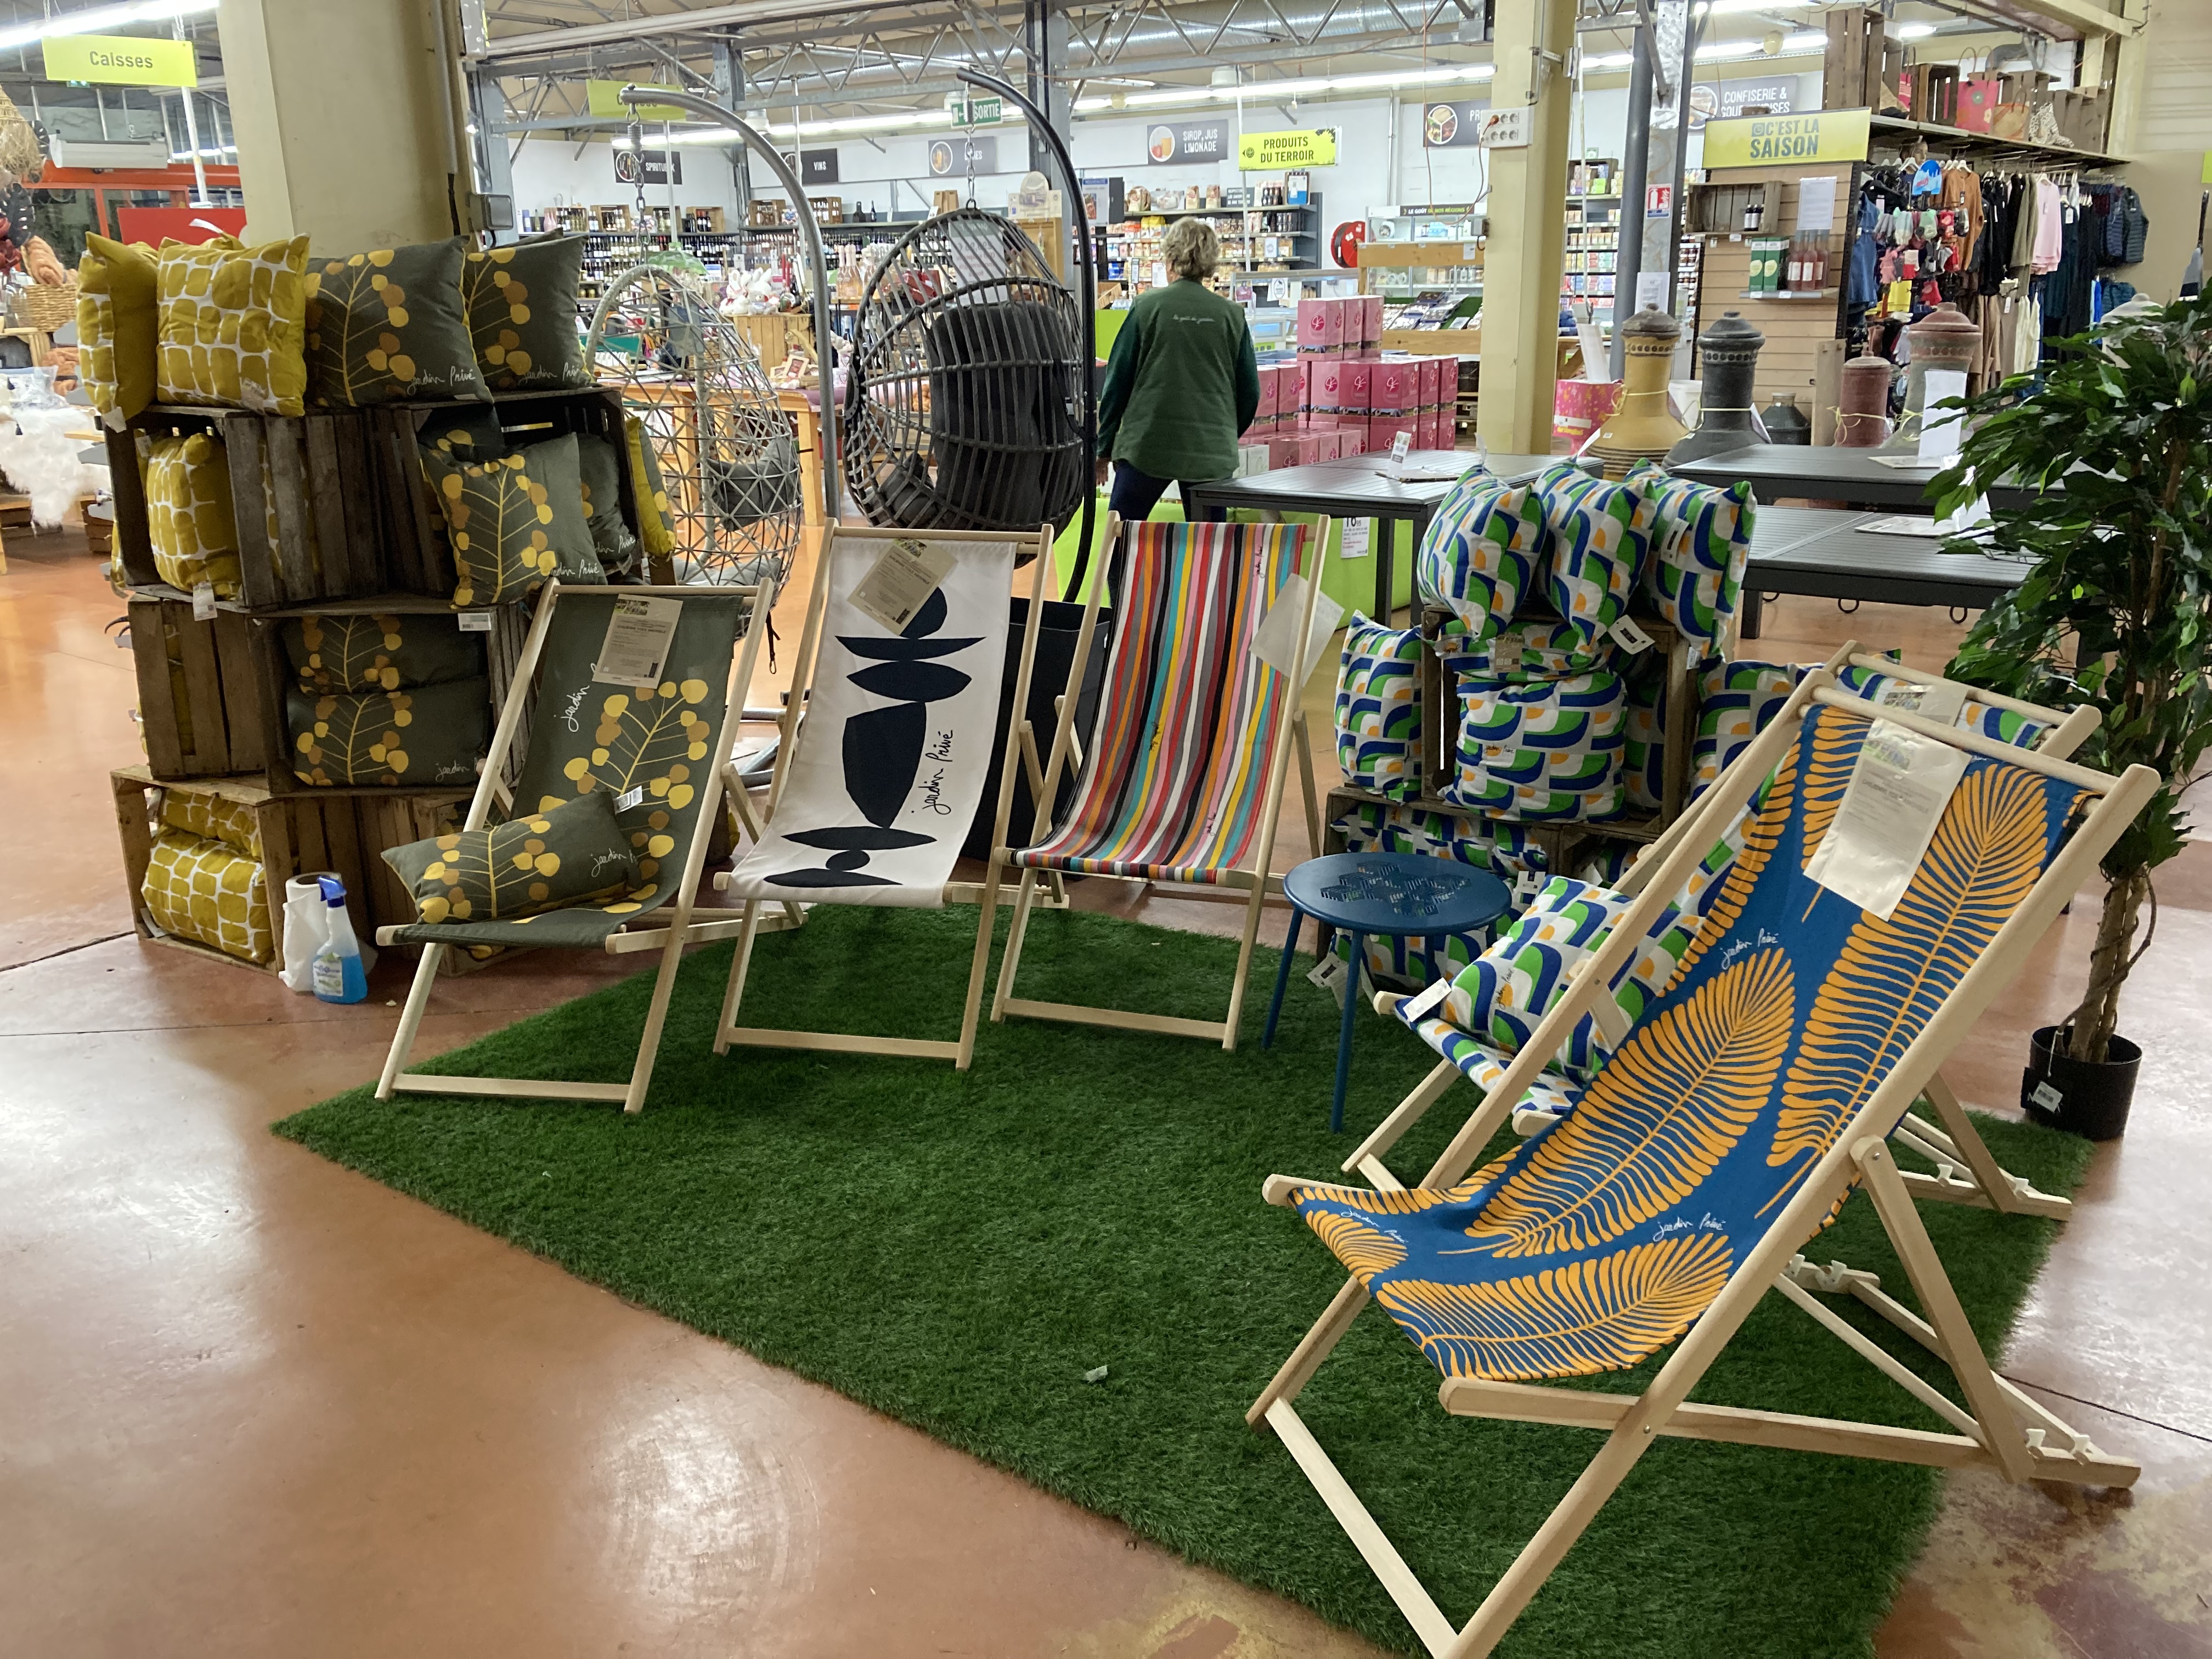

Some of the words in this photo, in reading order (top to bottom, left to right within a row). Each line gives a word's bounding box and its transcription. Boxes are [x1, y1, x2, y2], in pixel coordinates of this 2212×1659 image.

[89, 51, 153, 68] Caisses
[1724, 87, 1778, 104] CONFISERIE
[1779, 87, 1787, 99] &
[974, 103, 1000, 120] SORTIE
[1183, 130, 1204, 141] SIROP,
[1205, 129, 1217, 139] JUS
[1766, 120, 1800, 136] C'EST
[1804, 119, 1819, 133] LA
[1184, 141, 1217, 153] LIMONADE
[1264, 137, 1308, 150] PRODUITS
[1750, 135, 1819, 158] SAISON
[1261, 153, 1272, 163] DU
[1275, 150, 1314, 162] TERROIR
[813, 161, 827, 171] VINS
[925, 730, 953, 762] Privé
